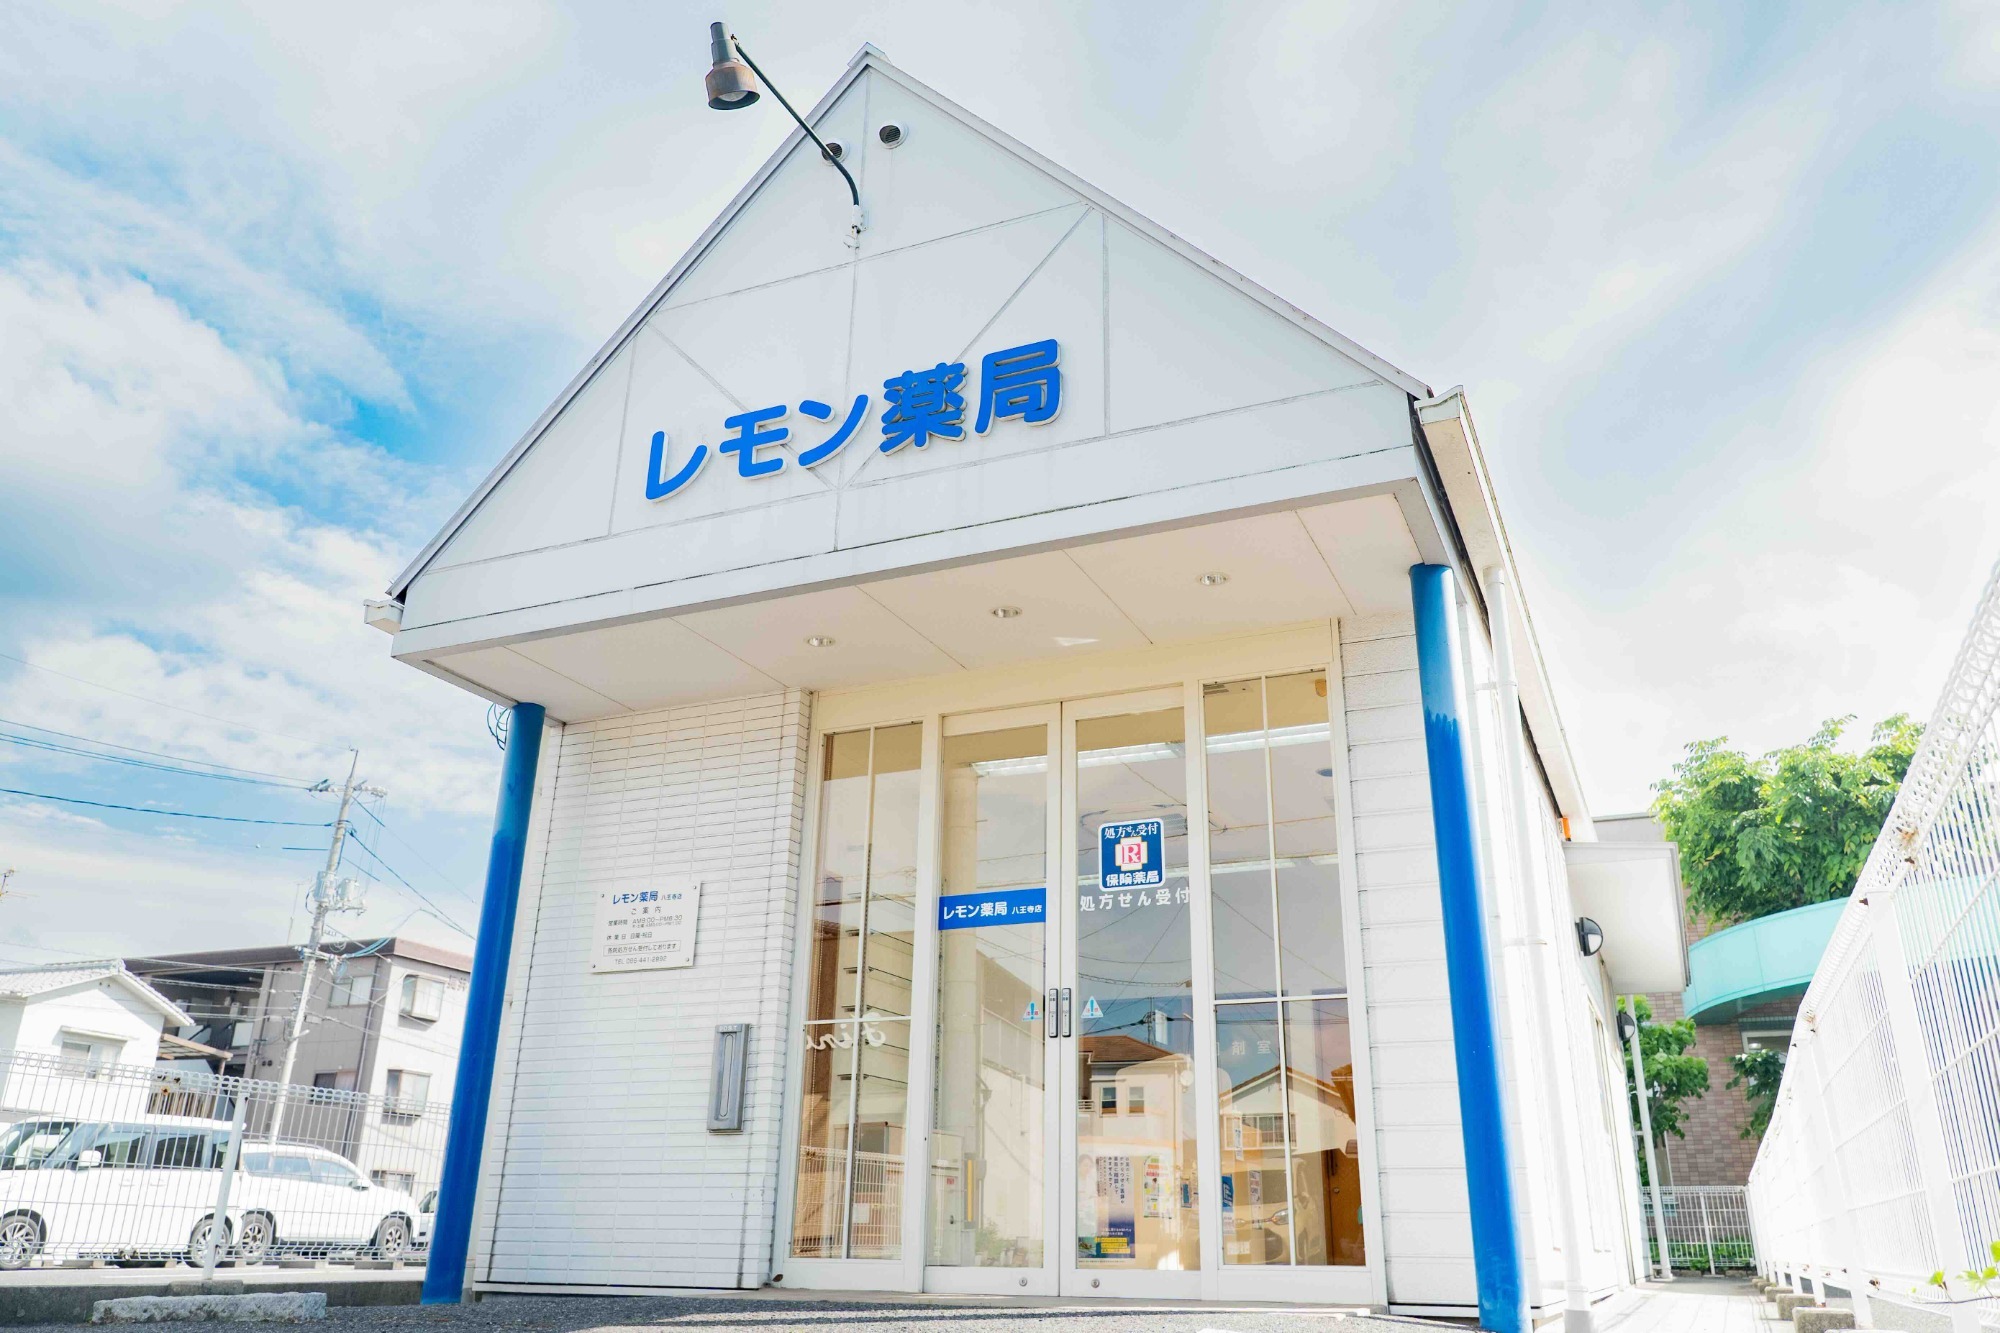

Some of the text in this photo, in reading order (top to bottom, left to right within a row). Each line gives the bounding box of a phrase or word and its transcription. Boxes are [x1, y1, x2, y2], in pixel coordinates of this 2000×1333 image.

[645, 338, 1063, 503] レモン薬局
[1104, 822, 1158, 840] 処方せん受付
[1105, 870, 1159, 886] 保険薬局
[612, 890, 659, 905] レモン薬局
[1080, 887, 1190, 912] 処方せん受付
[943, 901, 1042, 920] レモン薬局 八王寺店
